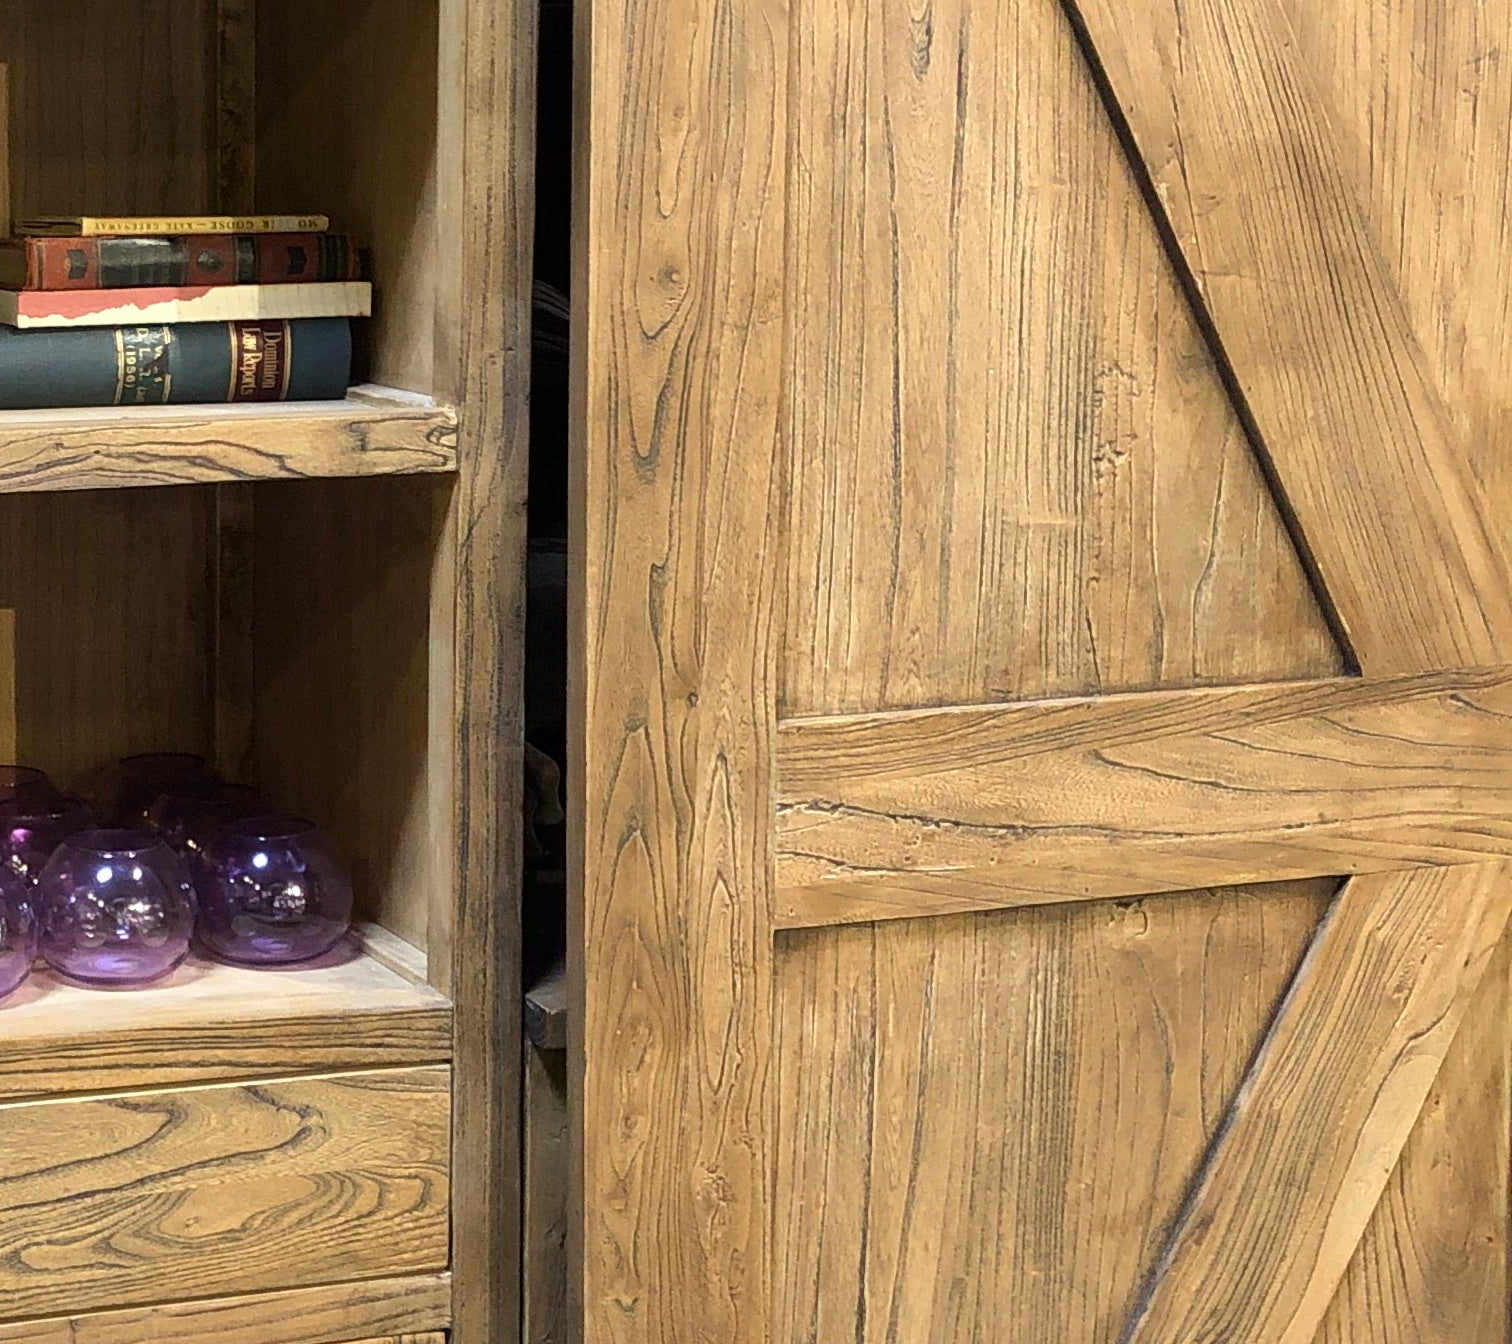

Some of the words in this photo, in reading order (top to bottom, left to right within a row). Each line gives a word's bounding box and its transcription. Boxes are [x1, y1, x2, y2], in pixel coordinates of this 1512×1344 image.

[165, 222, 193, 231] KATE
[211, 220, 254, 230] GOOSE
[241, 327, 261, 350] Law
[261, 331, 282, 389] Dominion
[240, 352, 263, 396] Reports
